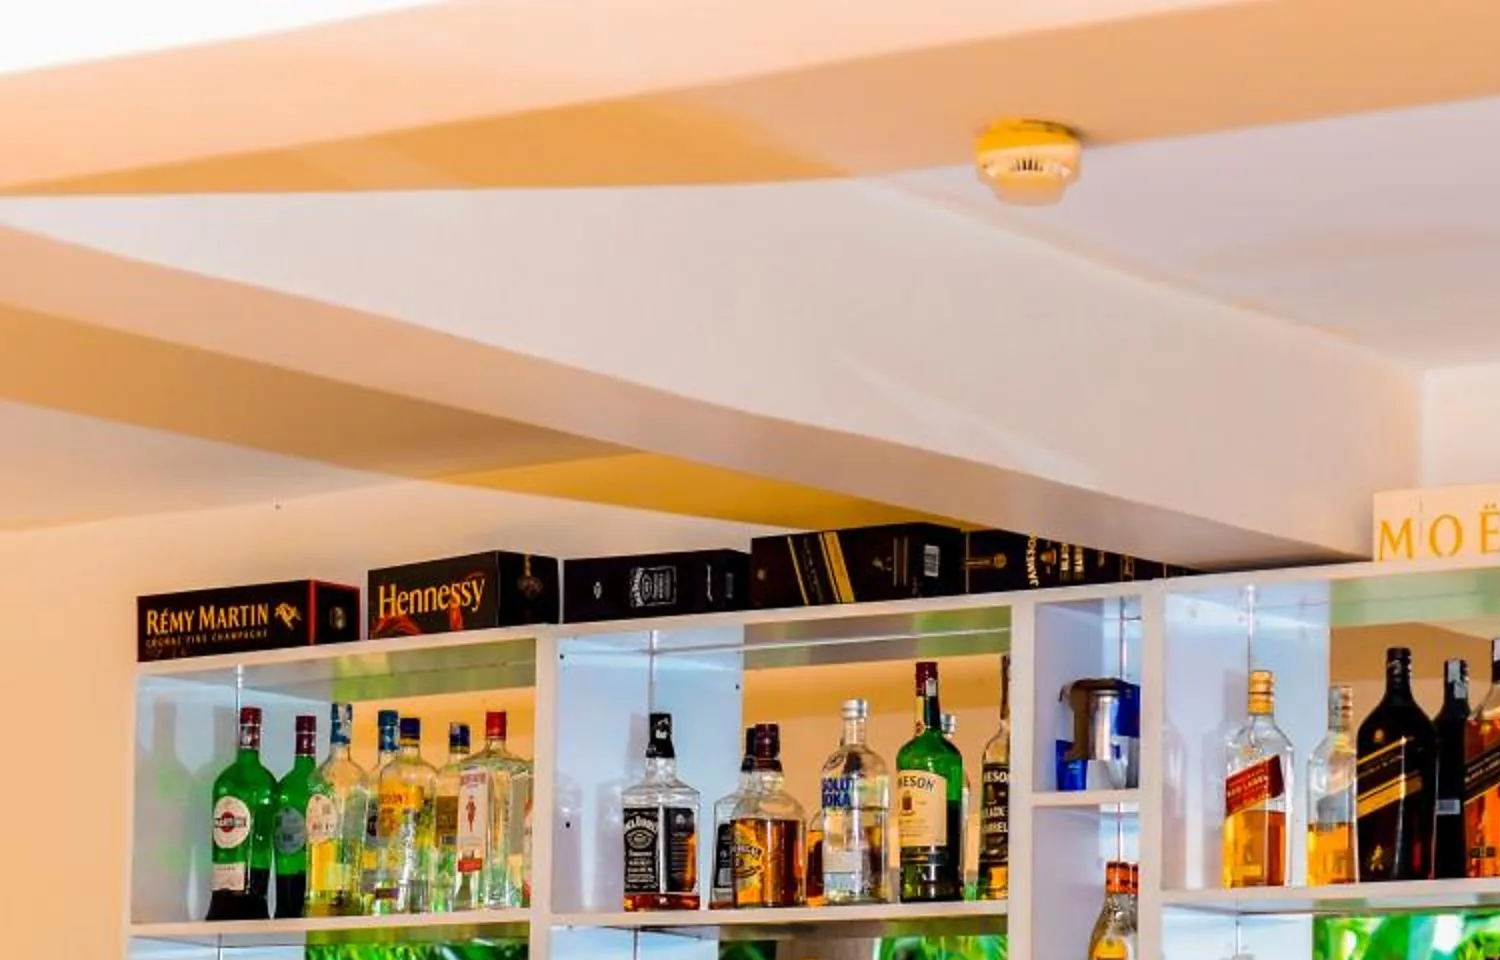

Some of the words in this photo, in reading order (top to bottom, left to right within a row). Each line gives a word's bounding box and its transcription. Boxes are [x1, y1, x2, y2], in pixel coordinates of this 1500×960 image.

[378, 578, 486, 619] Hennessy
[146, 608, 195, 635] RÉMY
[199, 603, 269, 631] MARTIN
